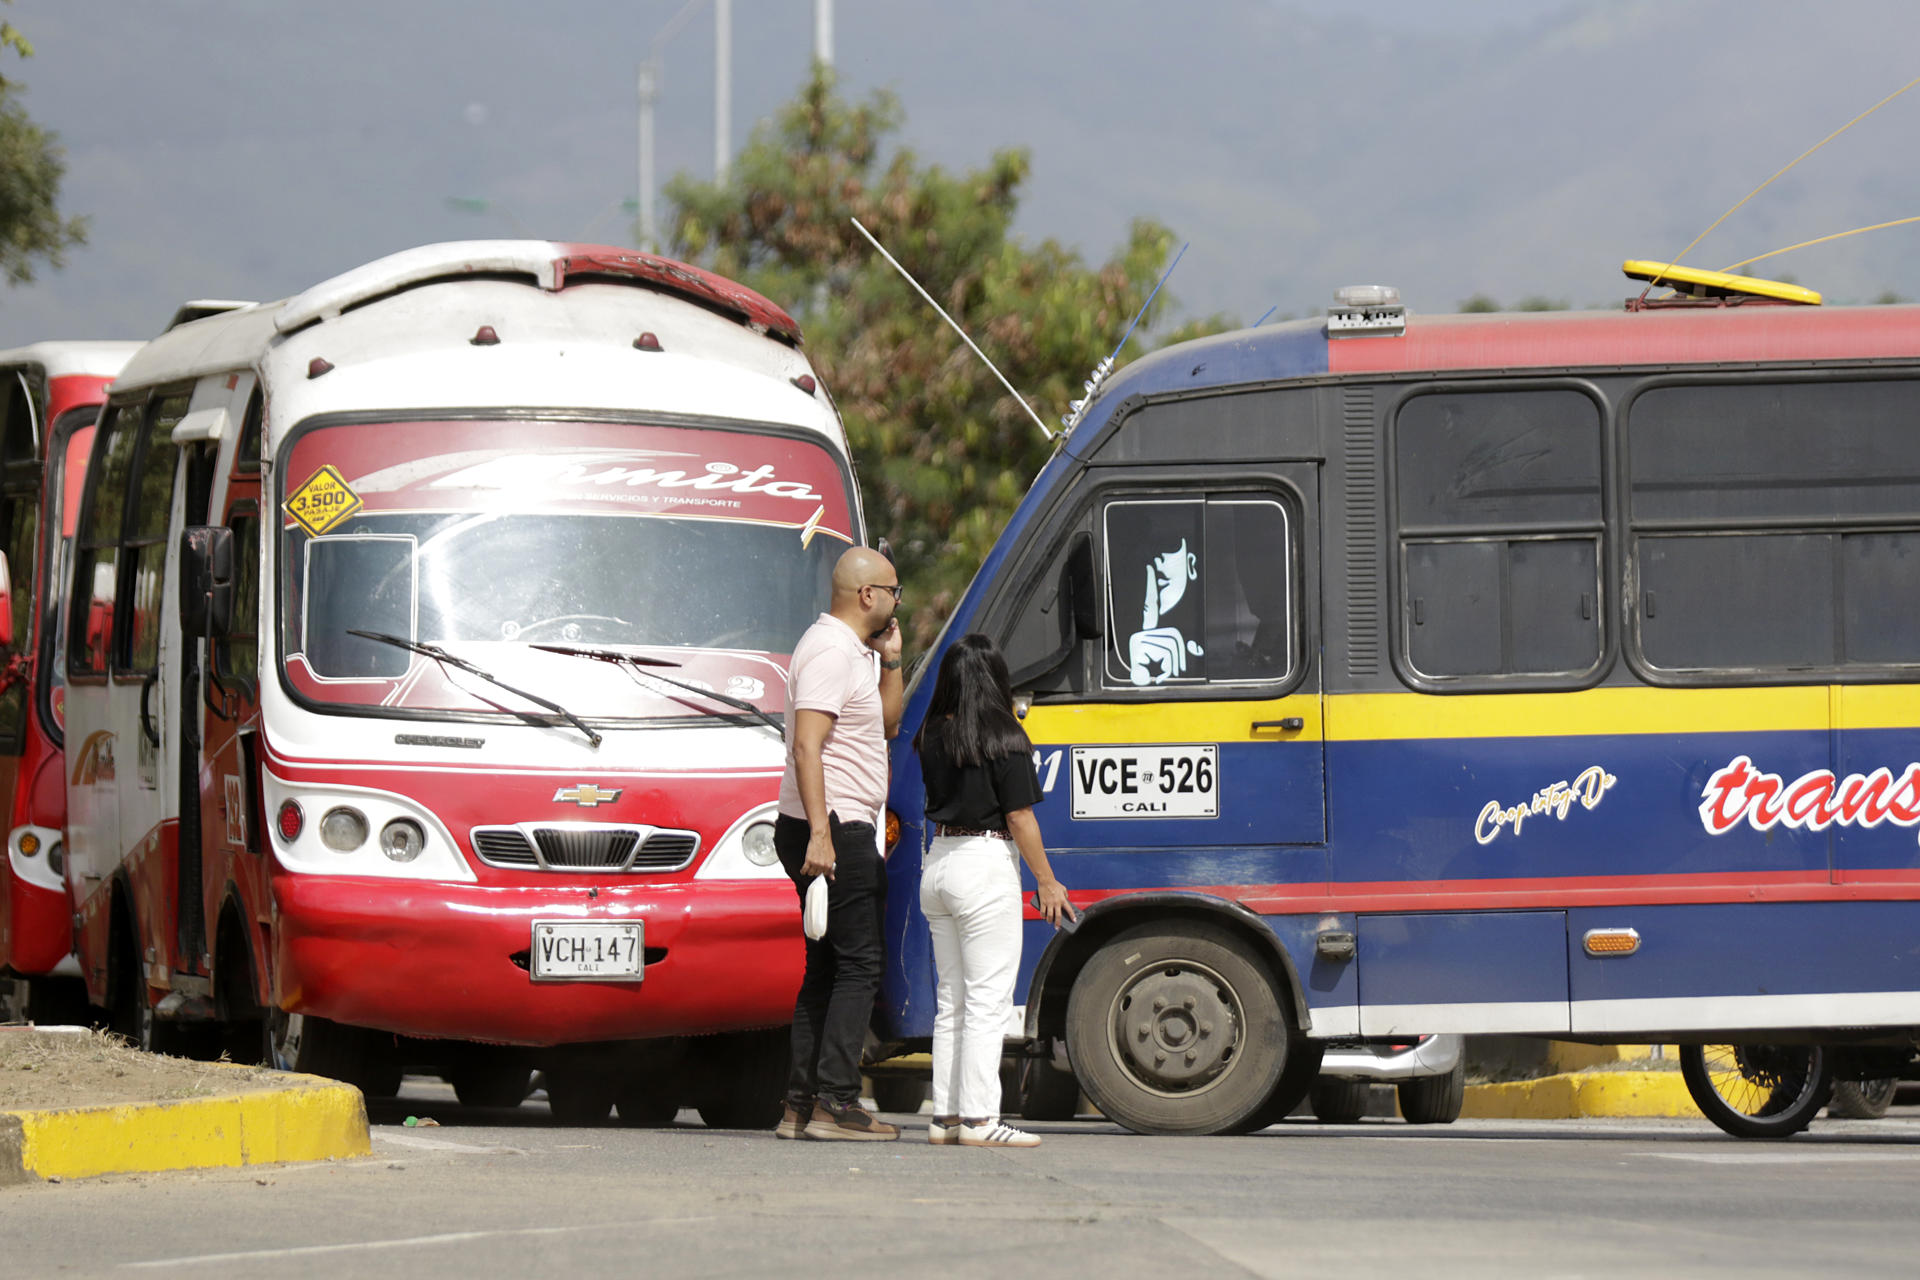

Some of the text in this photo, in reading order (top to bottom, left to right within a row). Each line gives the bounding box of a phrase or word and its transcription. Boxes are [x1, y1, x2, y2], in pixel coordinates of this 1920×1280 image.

[309, 482, 336, 493] VALOR
[296, 491, 346, 511] 3.500
[583, 493, 648, 502] SERVICIOS
[664, 496, 741, 508] TRANSPORTE
[1076, 756, 1213, 795] VCE 526
[1121, 802, 1167, 812] CALI
[541, 936, 636, 962] VCH 147
[577, 963, 600, 972] CALI
